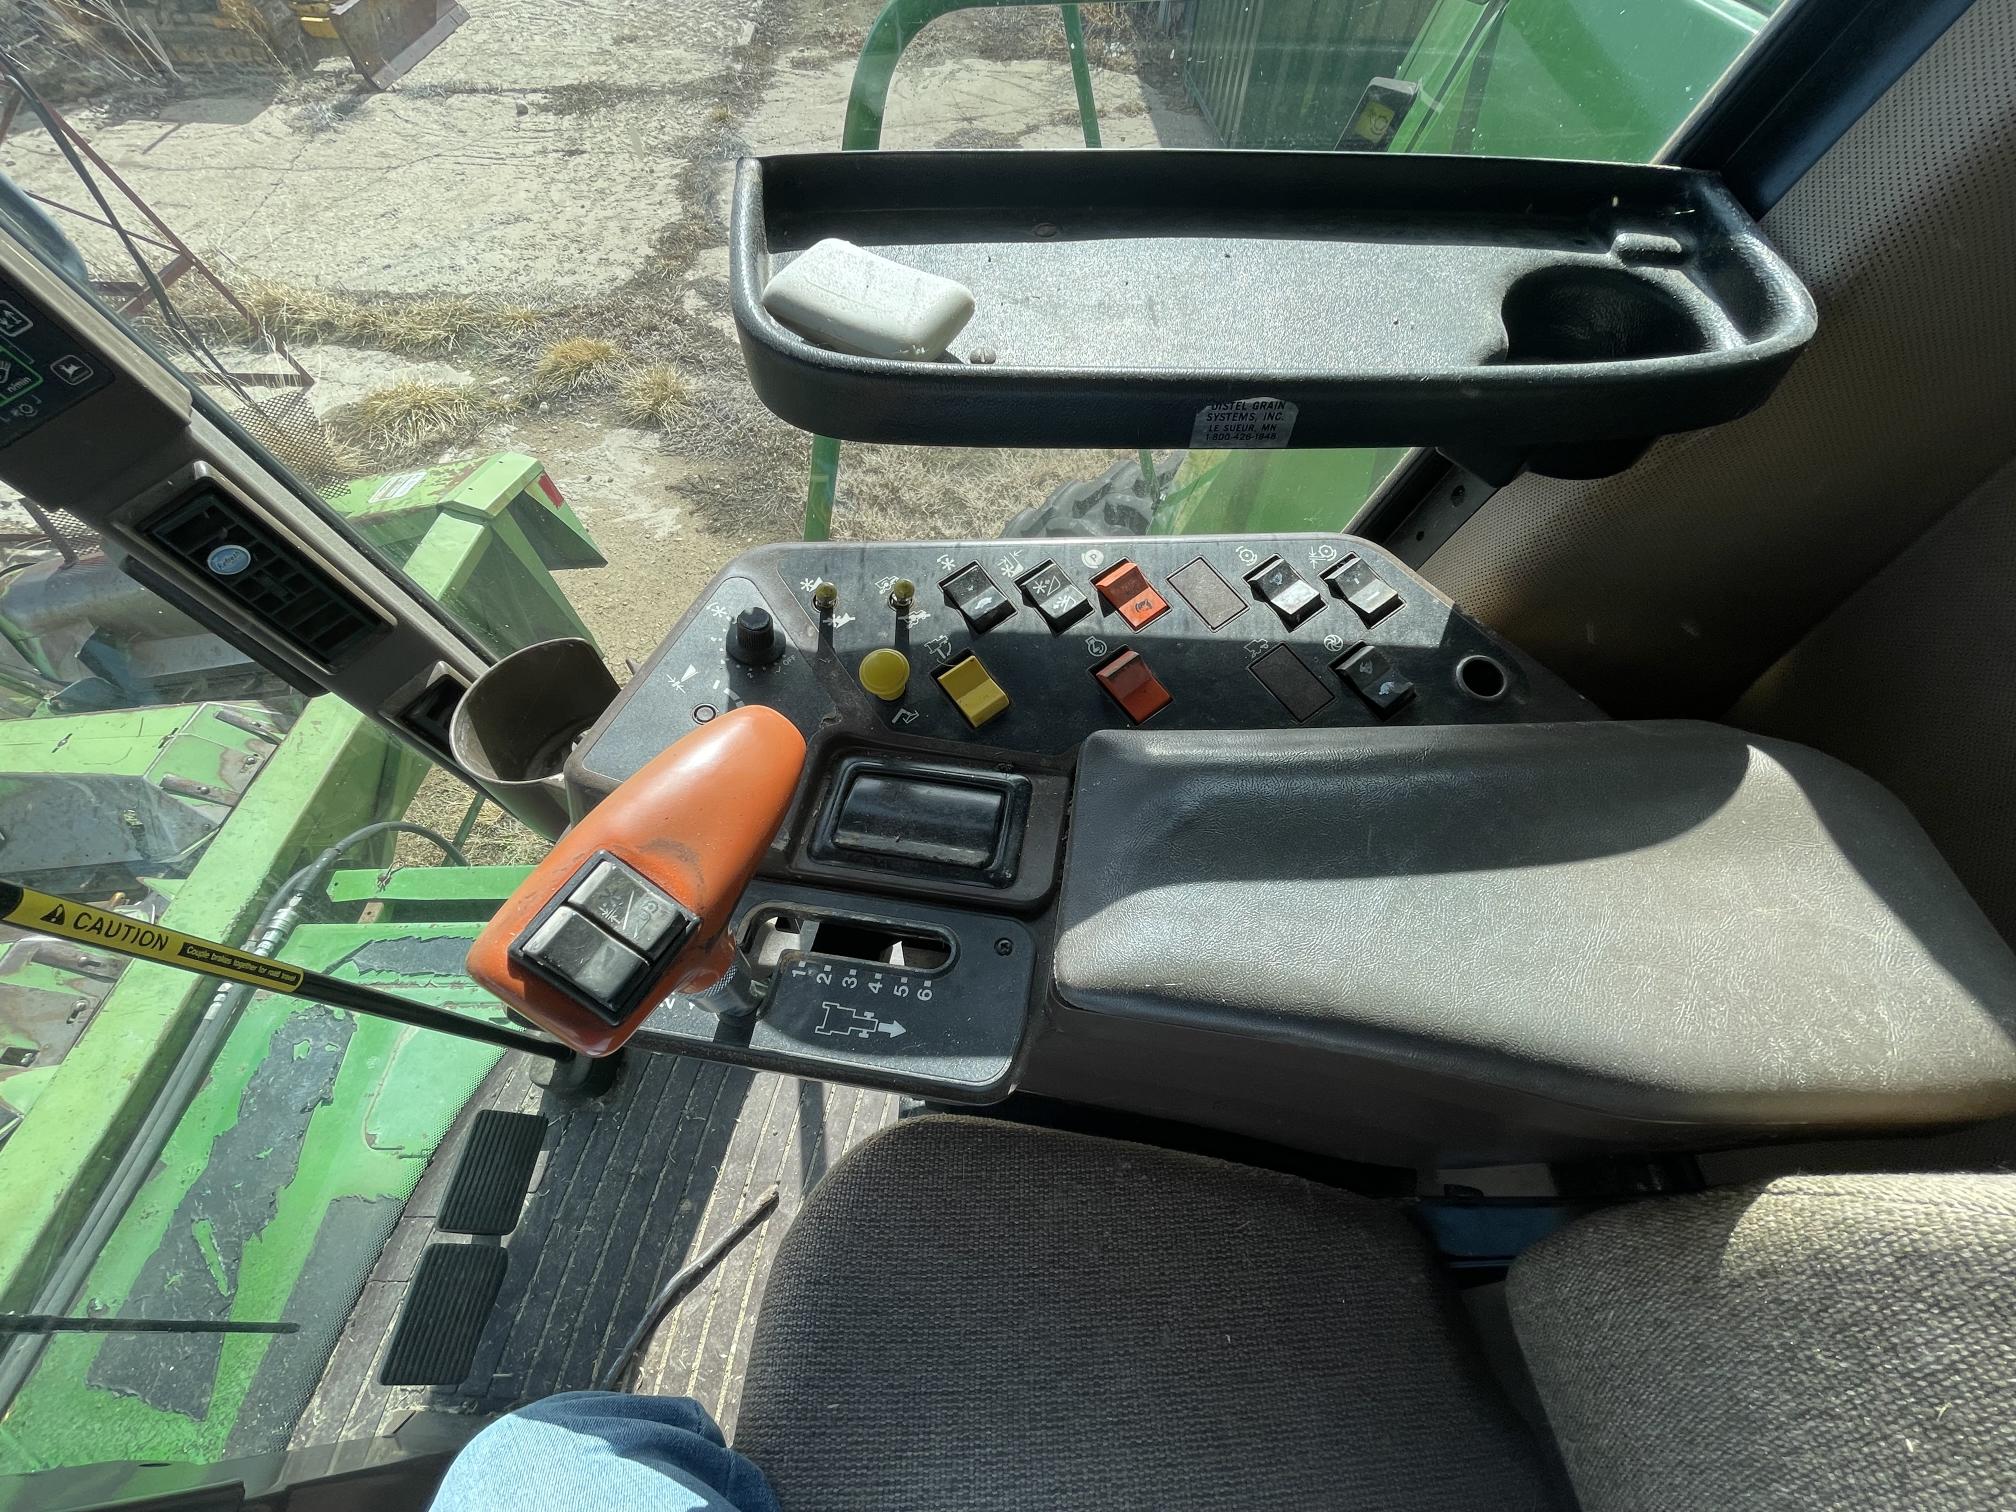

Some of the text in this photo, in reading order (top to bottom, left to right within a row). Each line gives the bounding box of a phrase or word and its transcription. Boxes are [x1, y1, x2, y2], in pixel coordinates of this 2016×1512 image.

[1252, 401, 1286, 410] GRAIN
[1206, 411, 1285, 422] SYSTEMS, INC.
[1208, 424, 1220, 432] LE
[1261, 423, 1277, 431] MN
[782, 654, 796, 666] OFF
[73, 912, 169, 951] CAUTION
[187, 946, 210, 959] Couple
[211, 953, 232, 965] brakes
[233, 960, 257, 970] together
[792, 969, 806, 977] 1
[816, 974, 832, 986] 2
[842, 976, 858, 989] 3
[868, 981, 883, 994] 4
[893, 985, 909, 997] 5
[917, 988, 933, 1001] 6
